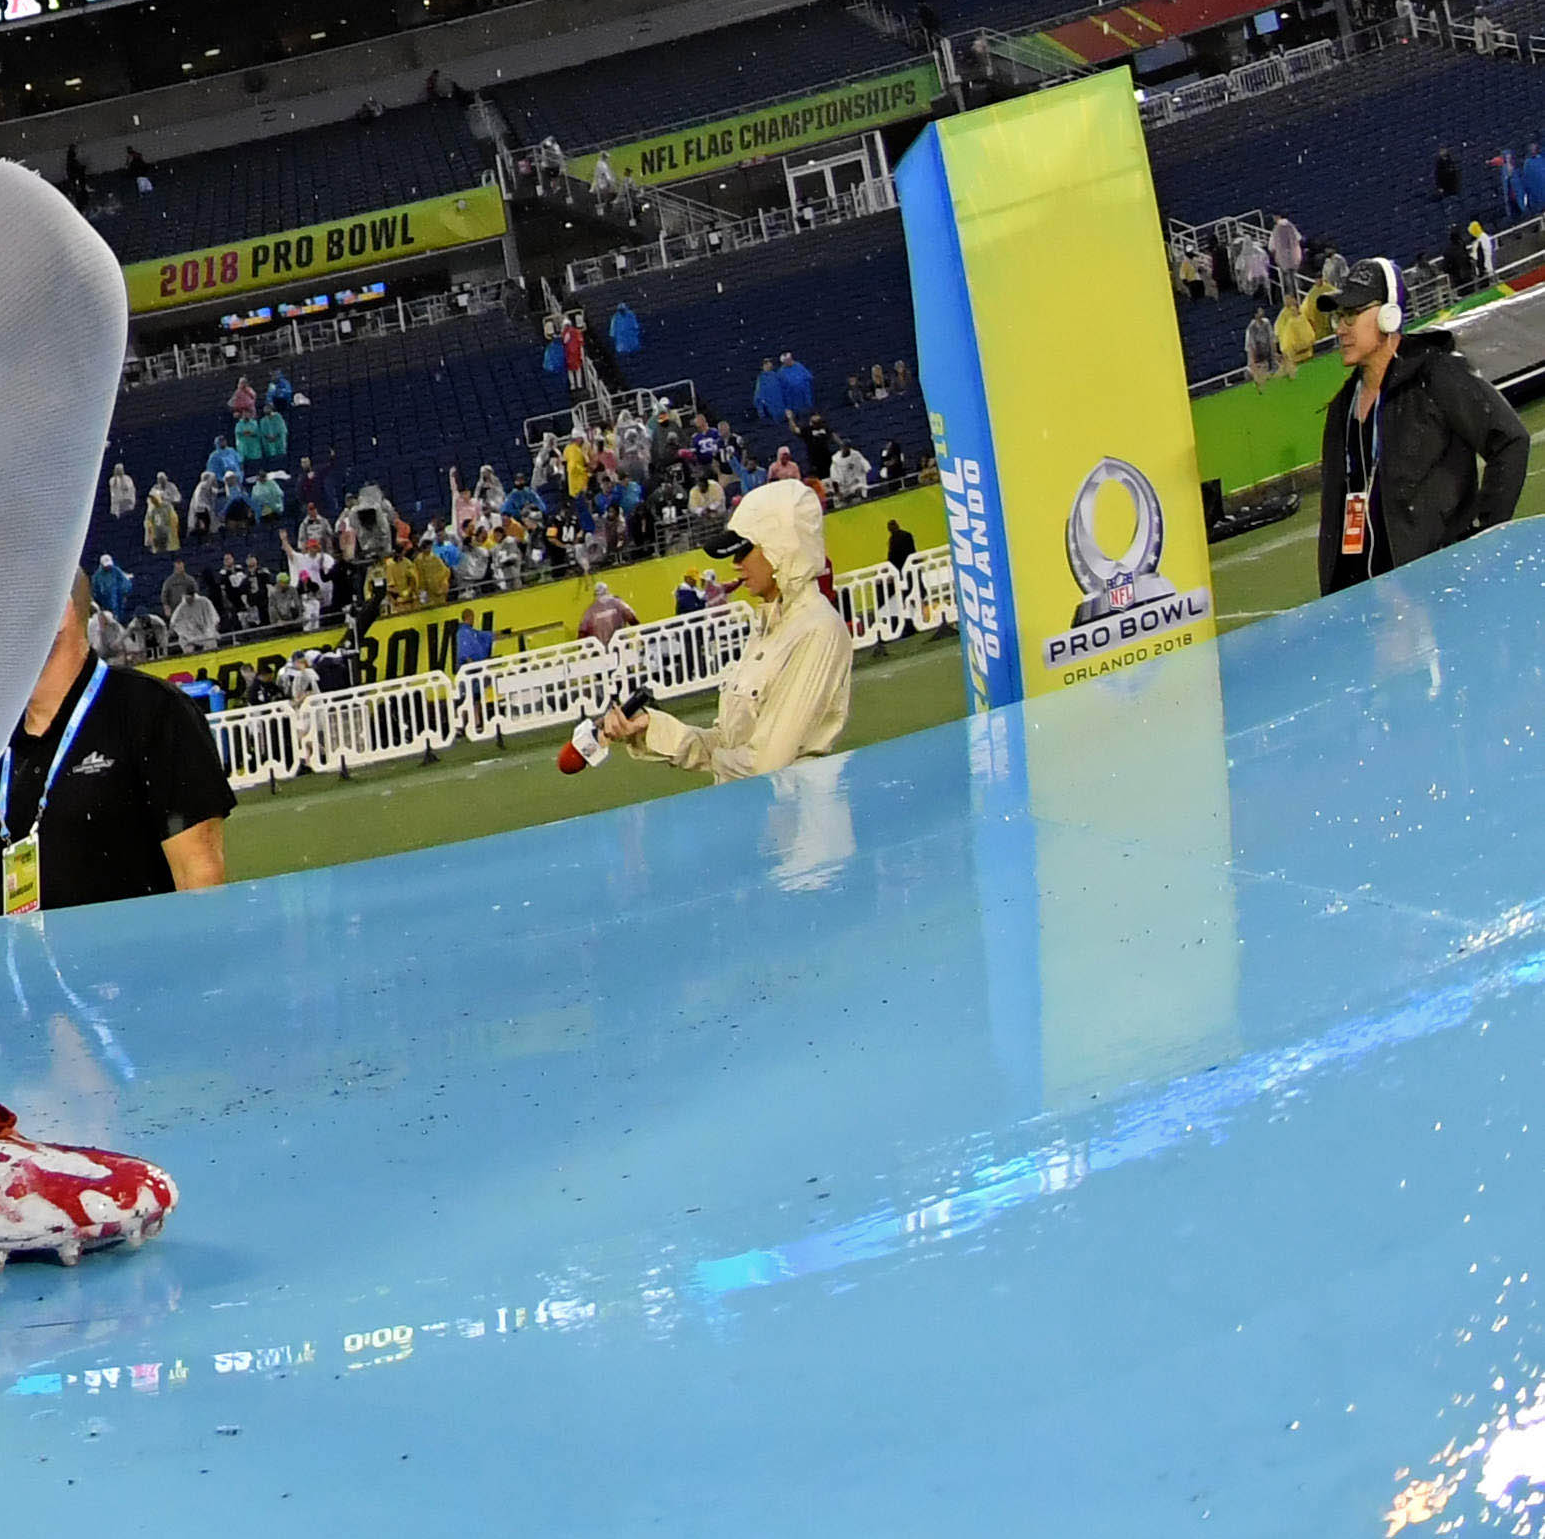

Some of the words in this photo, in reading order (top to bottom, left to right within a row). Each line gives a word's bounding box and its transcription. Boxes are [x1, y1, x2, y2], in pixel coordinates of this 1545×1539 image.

[640, 142, 679, 176] NFL
[684, 128, 735, 166] FLAG
[738, 79, 917, 151] CHAMPIONSHIPS
[159, 250, 240, 298] 2018
[251, 235, 314, 278] PRO
[326, 212, 415, 263] BOWL
[929, 411, 948, 459] 18
[939, 457, 989, 676] BOWL
[963, 458, 1001, 659] ORLANDO
[1109, 586, 1133, 607] NFL
[1049, 625, 1111, 663] PRO
[1119, 596, 1204, 640] BOWL
[1063, 647, 1148, 686] ORLANDO
[1153, 632, 1193, 656] 2018
